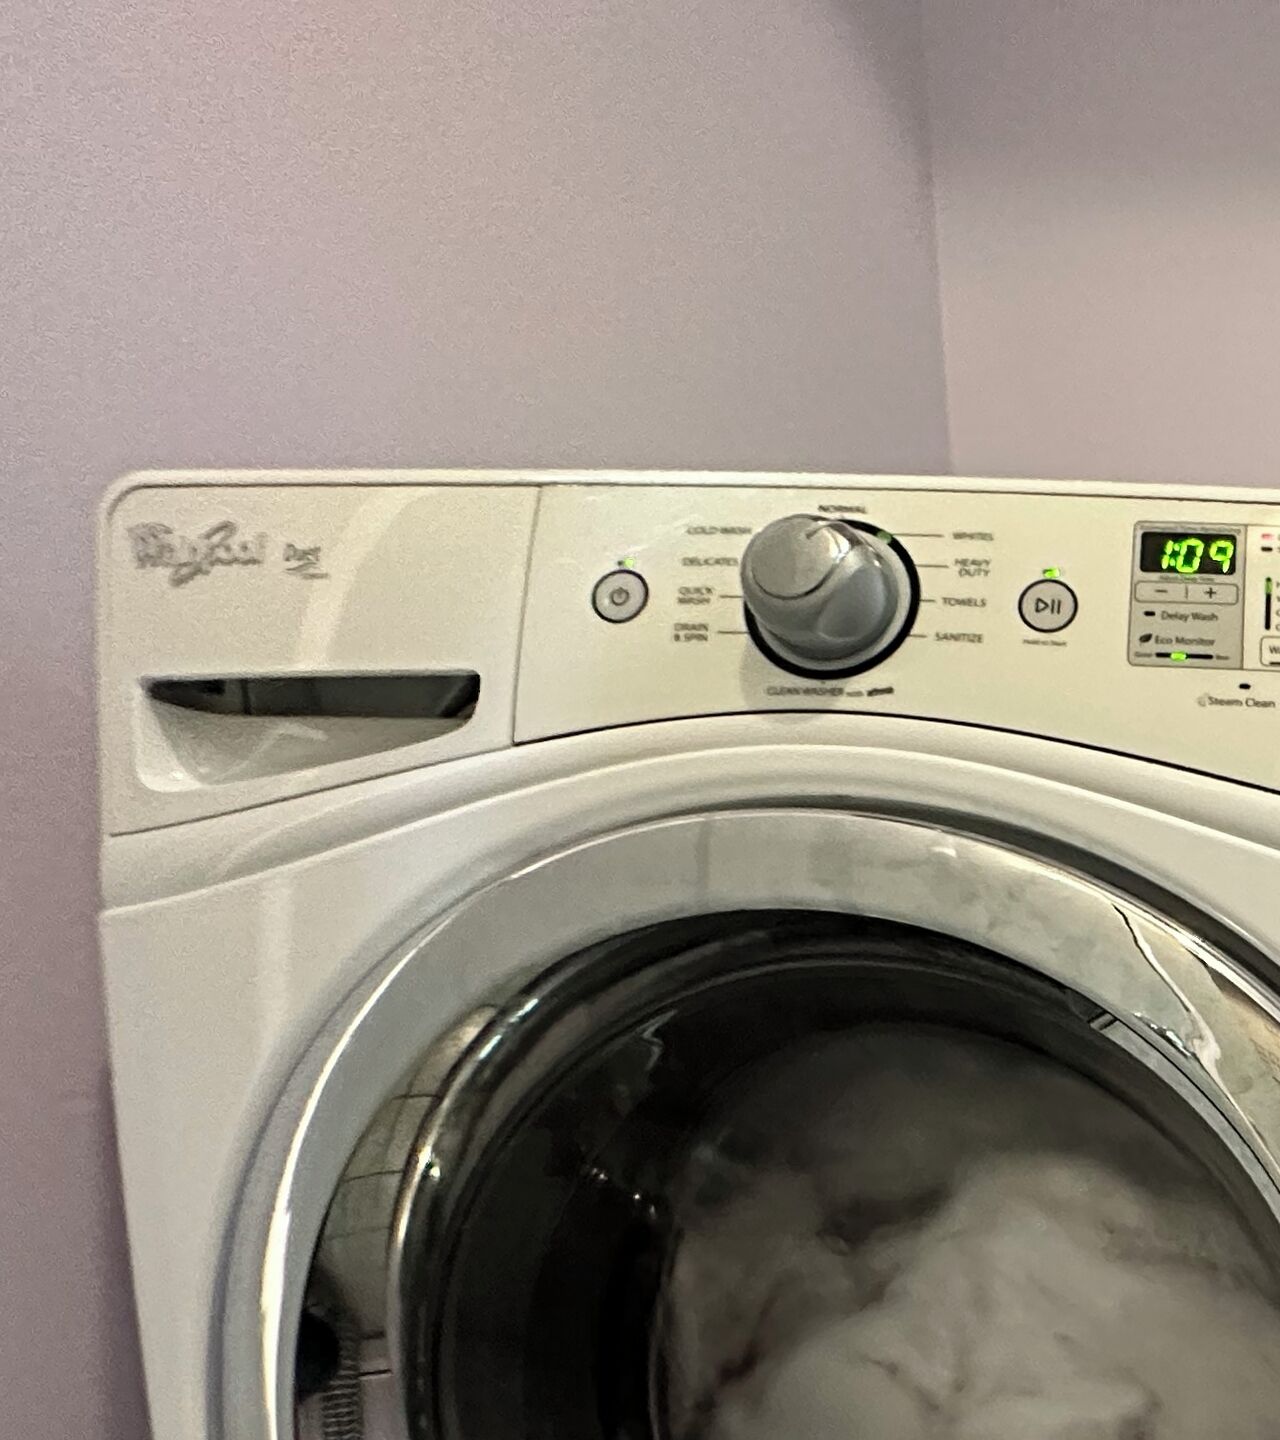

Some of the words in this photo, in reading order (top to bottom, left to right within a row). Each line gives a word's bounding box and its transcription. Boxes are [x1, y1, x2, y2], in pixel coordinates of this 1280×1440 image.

[1161, 538, 1235, 573] 1:09
[681, 557, 738, 566] DELICATES
[955, 558, 991, 567] HEAVY
[959, 567, 990, 577] DUTY
[942, 597, 987, 608] TOWELS
[1160, 610, 1190, 623] Delay
[1191, 612, 1218, 621] Wash
[674, 623, 709, 632] DRAIN
[935, 632, 983, 643] SANITIZE
[1154, 635, 1173, 645] Eco
[1208, 695, 1242, 707] Steam
[1244, 697, 1275, 709] Clean
